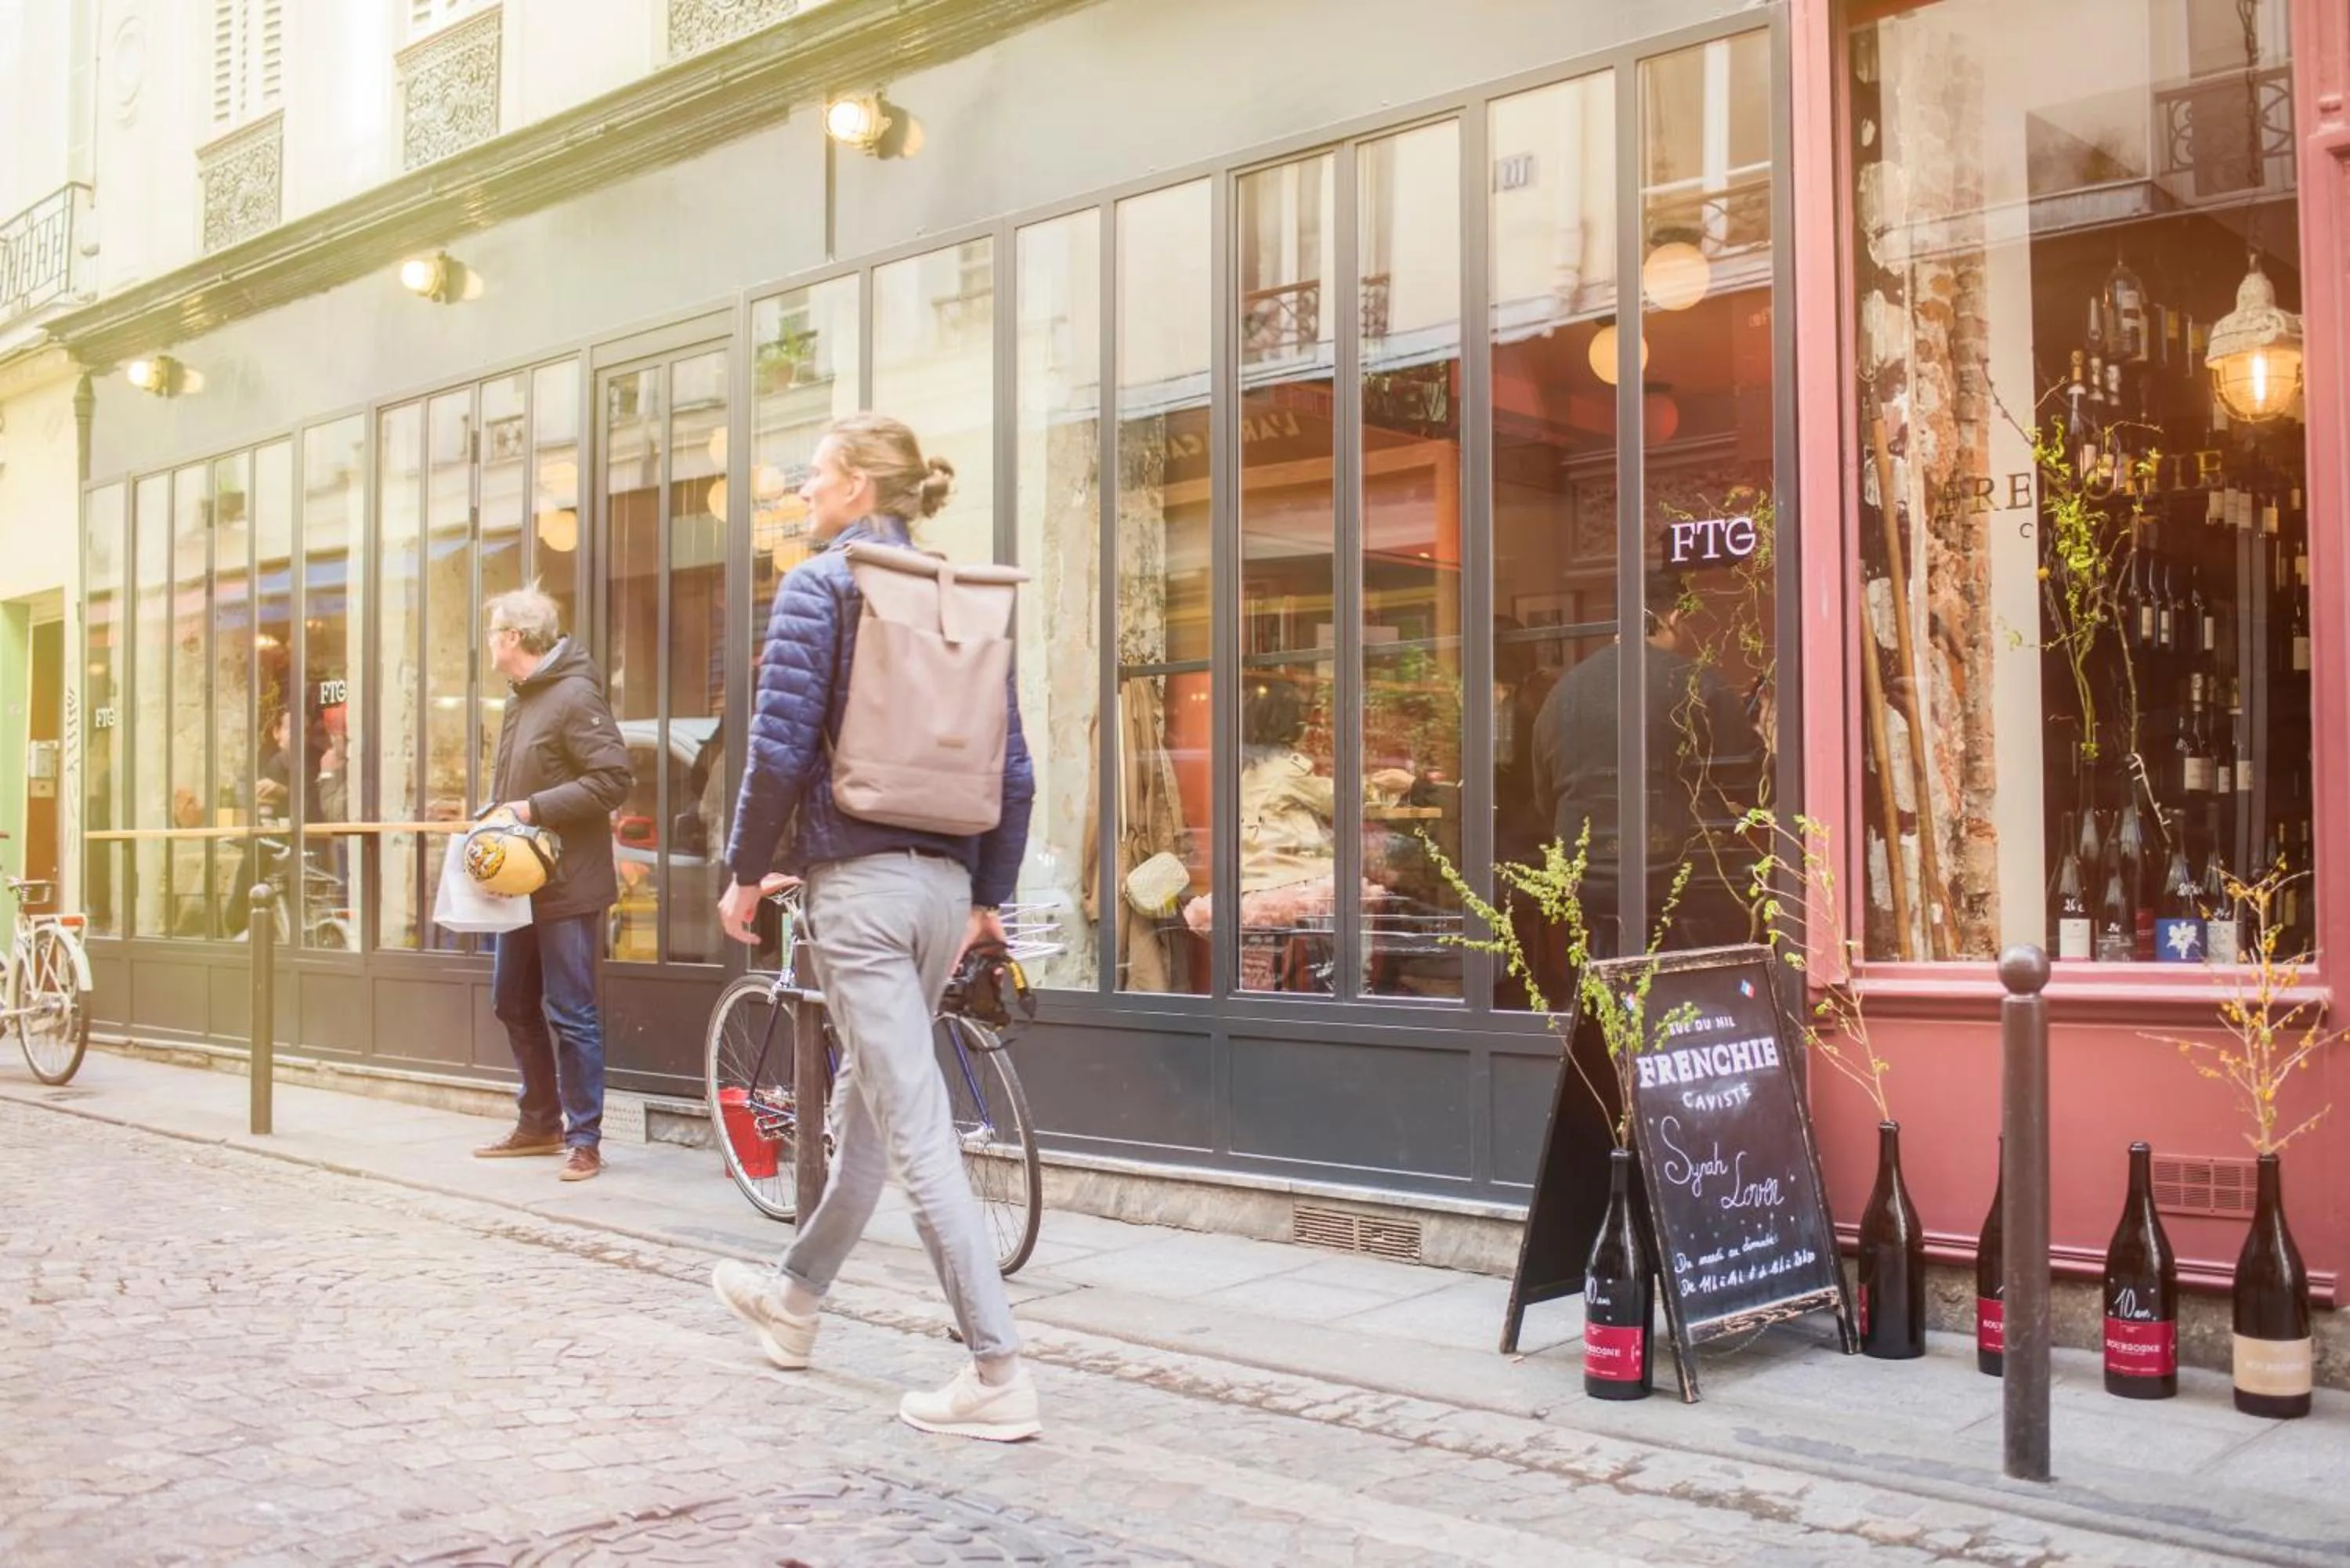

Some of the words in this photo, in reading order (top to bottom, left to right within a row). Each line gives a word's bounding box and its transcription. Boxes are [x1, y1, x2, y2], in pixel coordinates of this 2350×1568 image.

[1670, 516, 1756, 562] FTG
[320, 680, 349, 704] FTG
[1694, 1019, 1711, 1031] DU
[1716, 1017, 1737, 1028] NIL
[1636, 1036, 1780, 1088] FRENCHIE
[1682, 1082, 1752, 1111] CAVISTE
[1661, 1115, 1729, 1198] Syrah
[2113, 1288, 2136, 1318] 10
